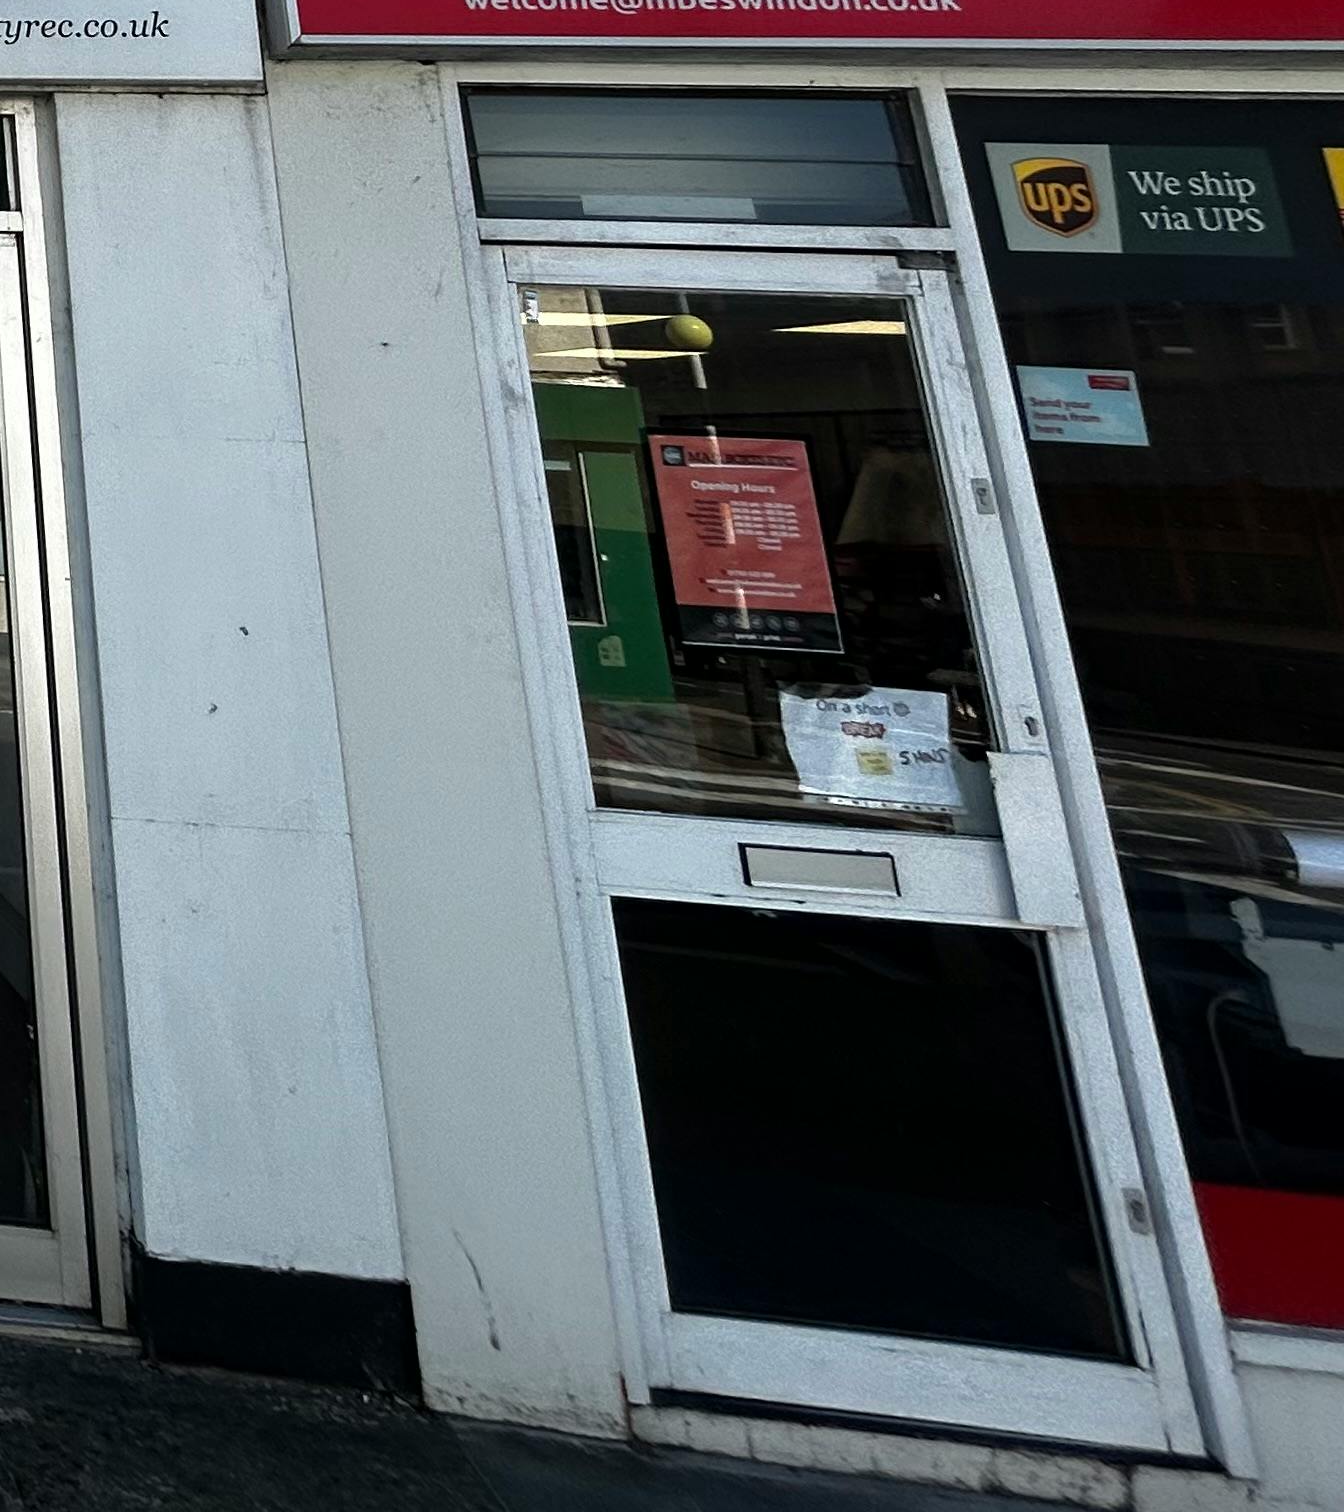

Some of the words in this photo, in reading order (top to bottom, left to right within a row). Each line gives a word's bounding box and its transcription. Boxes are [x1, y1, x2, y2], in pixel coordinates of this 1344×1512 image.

[1127, 170, 1182, 197] We
[1190, 171, 1256, 203] ship
[1023, 179, 1091, 232] ups
[1142, 205, 1195, 231] via
[1201, 205, 1266, 233] UPS
[691, 480, 739, 493] Opening
[741, 483, 776, 494] Hours
[816, 700, 837, 712] On
[843, 704, 851, 713] a
